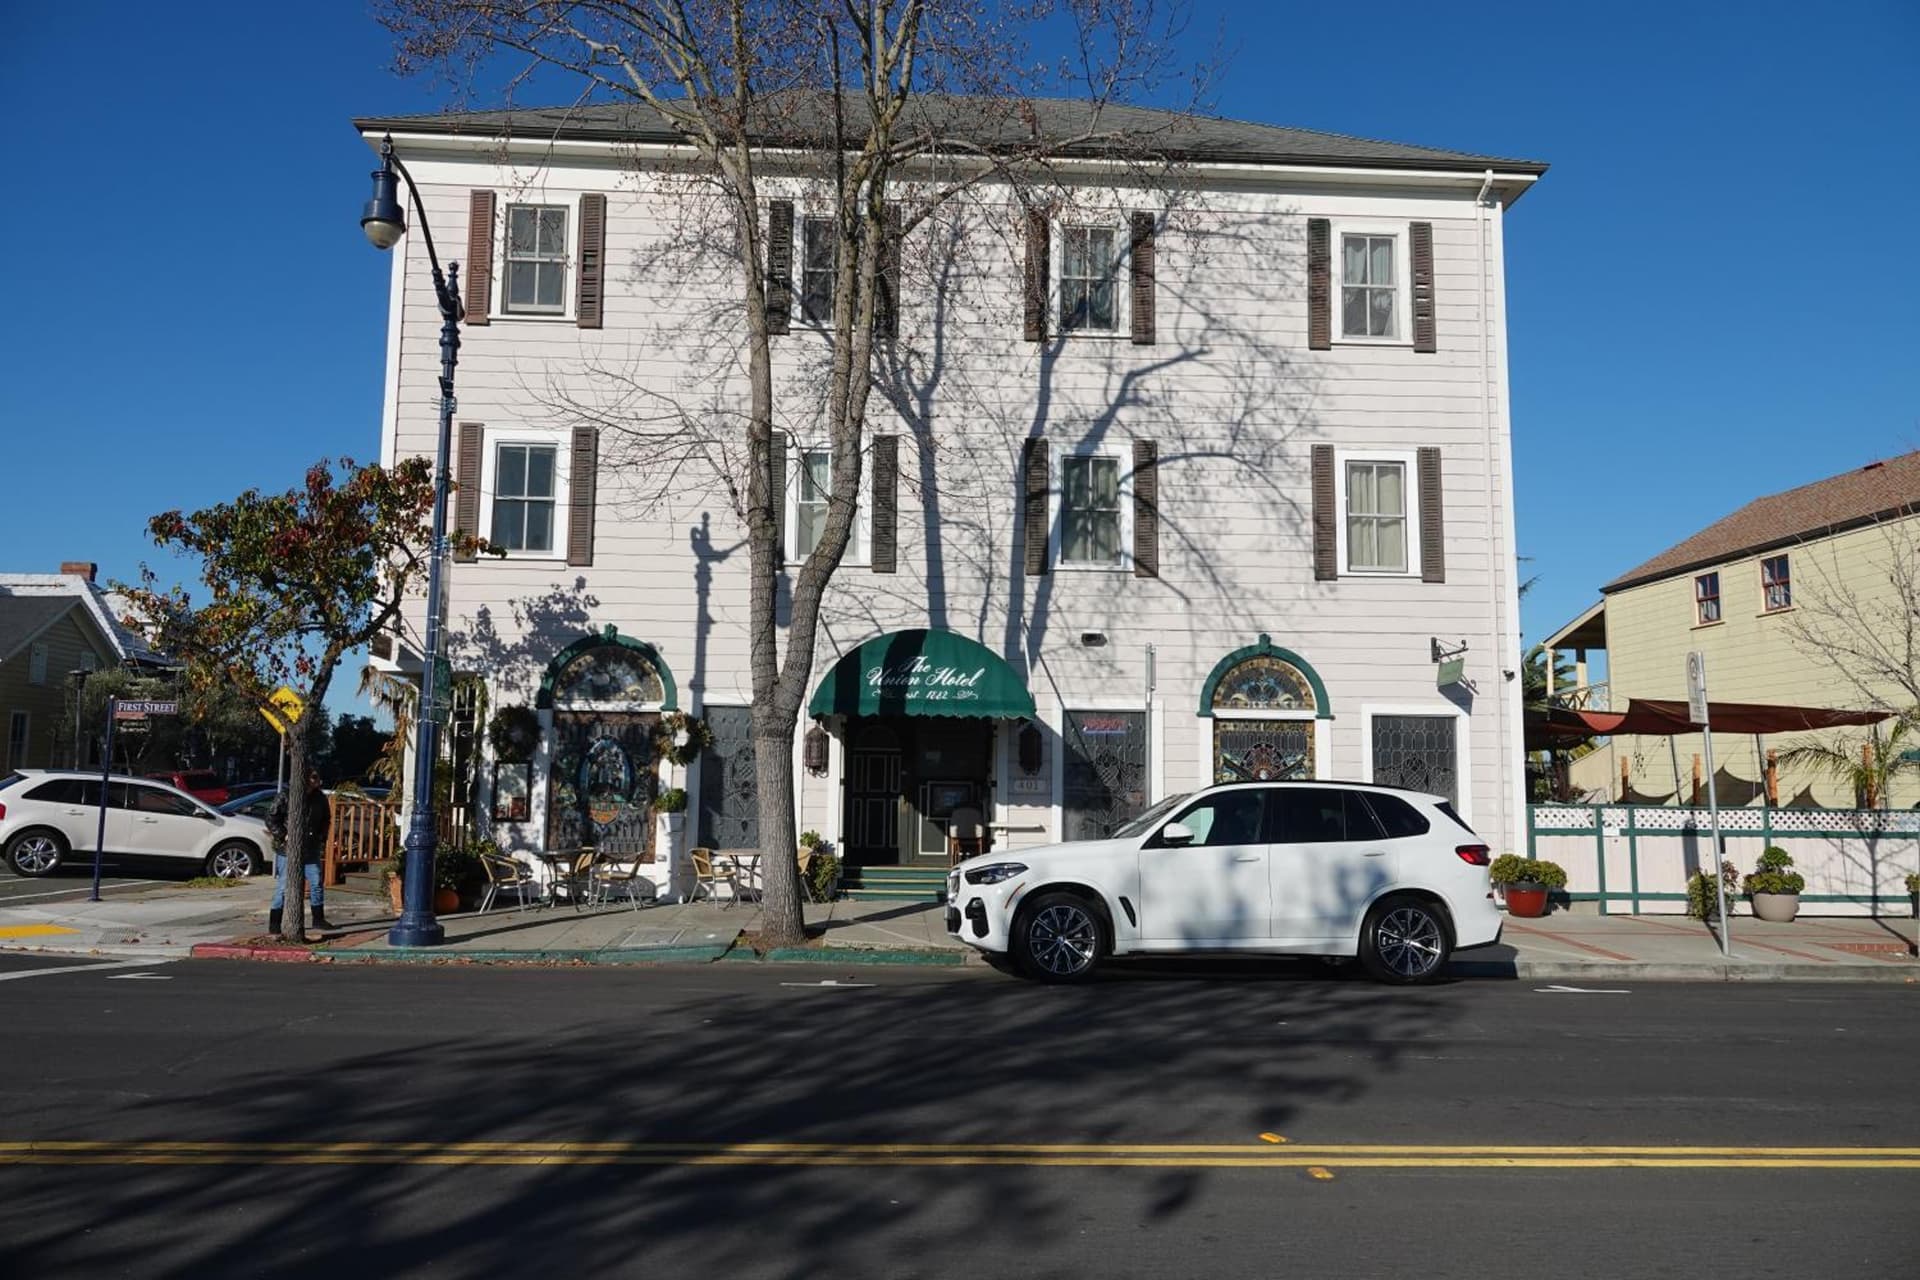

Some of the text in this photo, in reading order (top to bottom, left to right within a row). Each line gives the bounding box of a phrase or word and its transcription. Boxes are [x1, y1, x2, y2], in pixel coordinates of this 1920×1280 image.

[899, 655, 932, 673] The
[866, 665, 986, 687] Union Hotel
[118, 702, 175, 712] FIRST STREET
